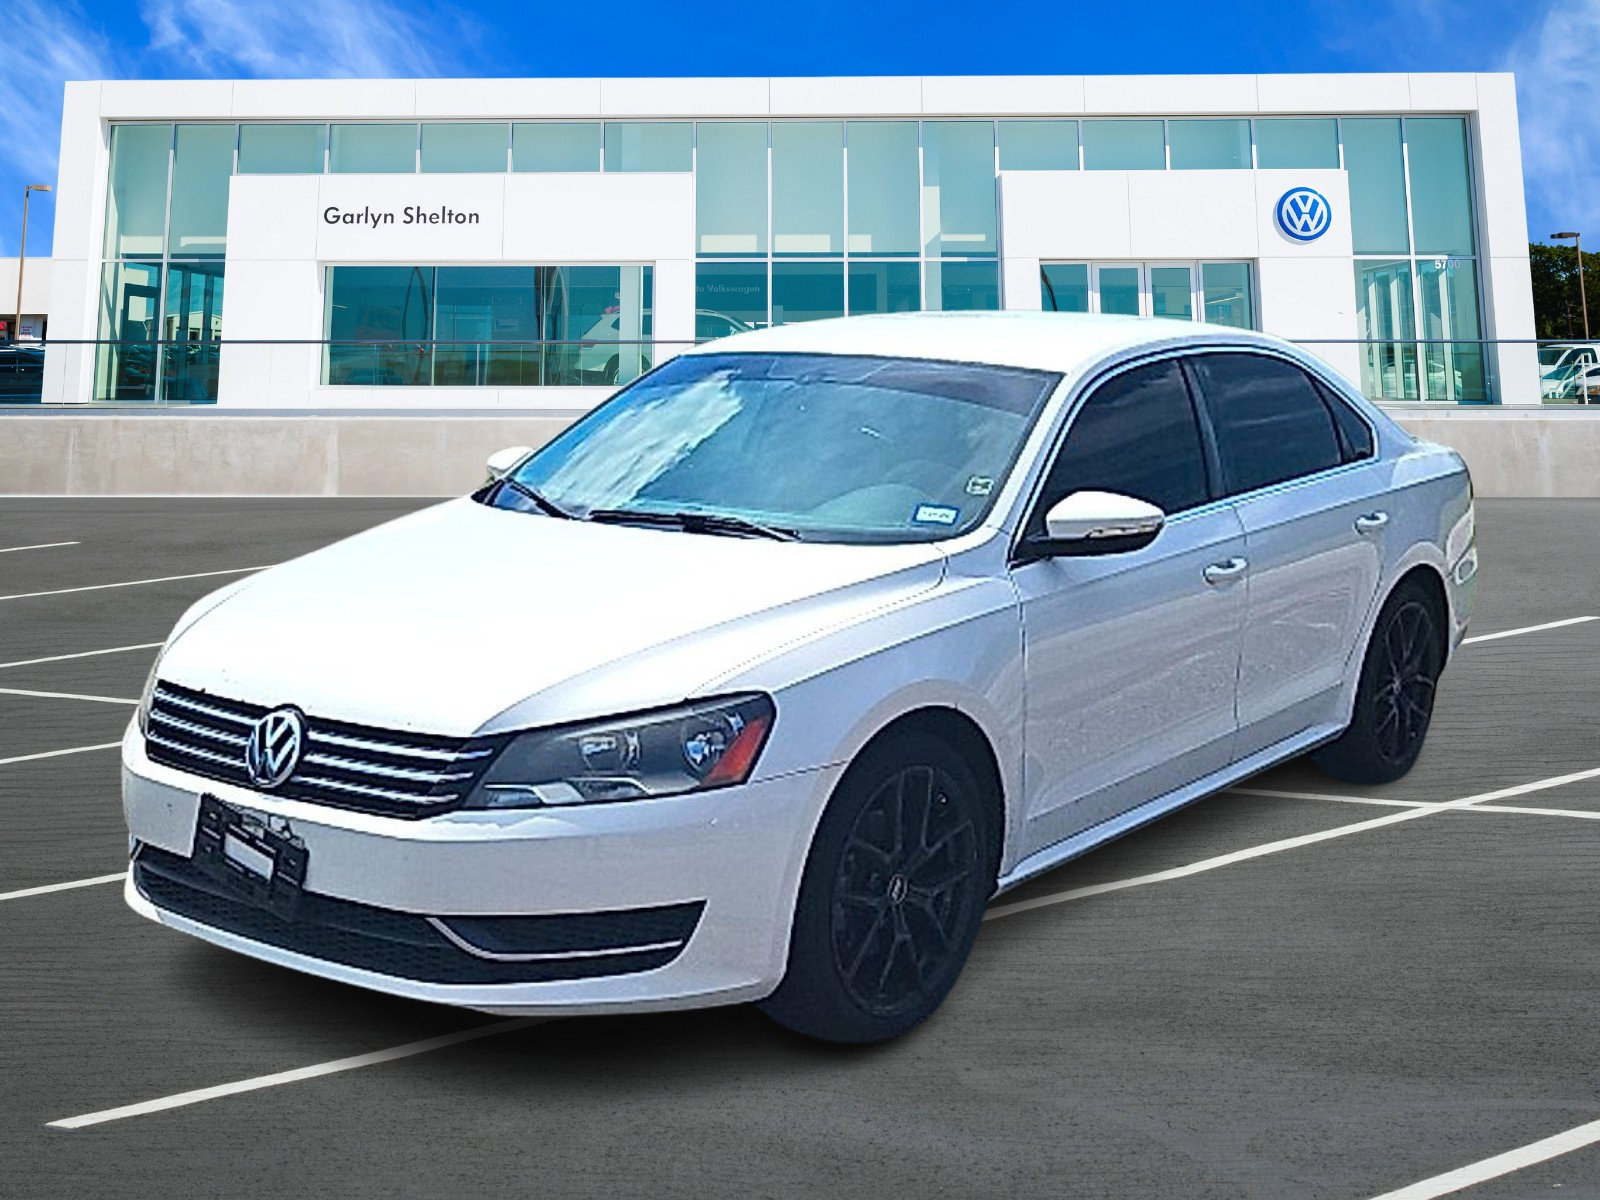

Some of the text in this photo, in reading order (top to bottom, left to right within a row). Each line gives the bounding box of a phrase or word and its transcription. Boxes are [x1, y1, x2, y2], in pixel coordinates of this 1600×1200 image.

[323, 205, 480, 229] Garlyn Shelton
[1280, 189, 1329, 238] VW
[707, 284, 760, 294] Volkswagen
